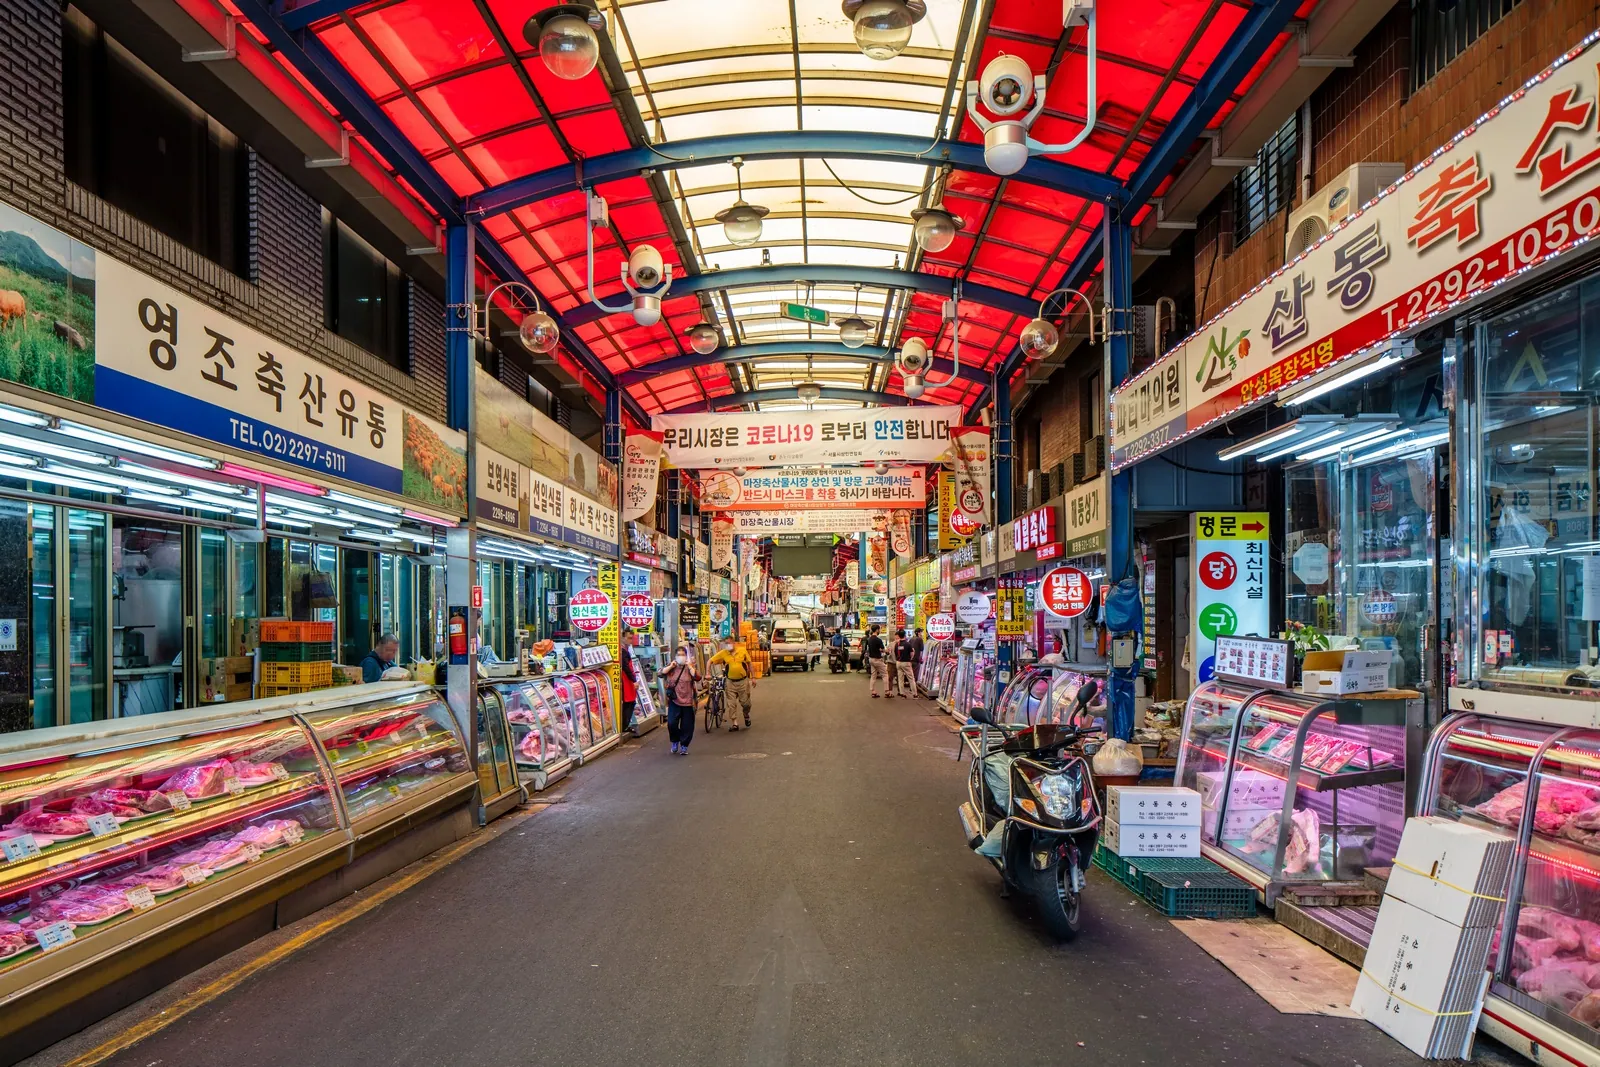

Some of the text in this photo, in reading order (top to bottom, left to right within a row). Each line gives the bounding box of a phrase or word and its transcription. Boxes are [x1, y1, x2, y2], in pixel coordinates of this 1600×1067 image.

[138, 297, 388, 449] 영조축산유통
[1240, 337, 1334, 403] 안성목장직영
[663, 419, 951, 449] 우리시장은 코로나19 로부터 안전합니다
[487, 460, 517, 499] 보영식품
[743, 476, 912, 489] 마장축산물시장 상인 및 방문 고객께서는
[743, 487, 915, 501] 반드시 마스크를 착용 하시기 바랍니다.
[740, 518, 794, 527] 마장축산물시장
[1199, 516, 1237, 538] 명문
[1246, 542, 1263, 599] 최신시설
[1051, 573, 1082, 587] 대림
[1052, 587, 1083, 601] 축산
[572, 605, 608, 617] 화신축산
[577, 620, 603, 628] 한우전문
